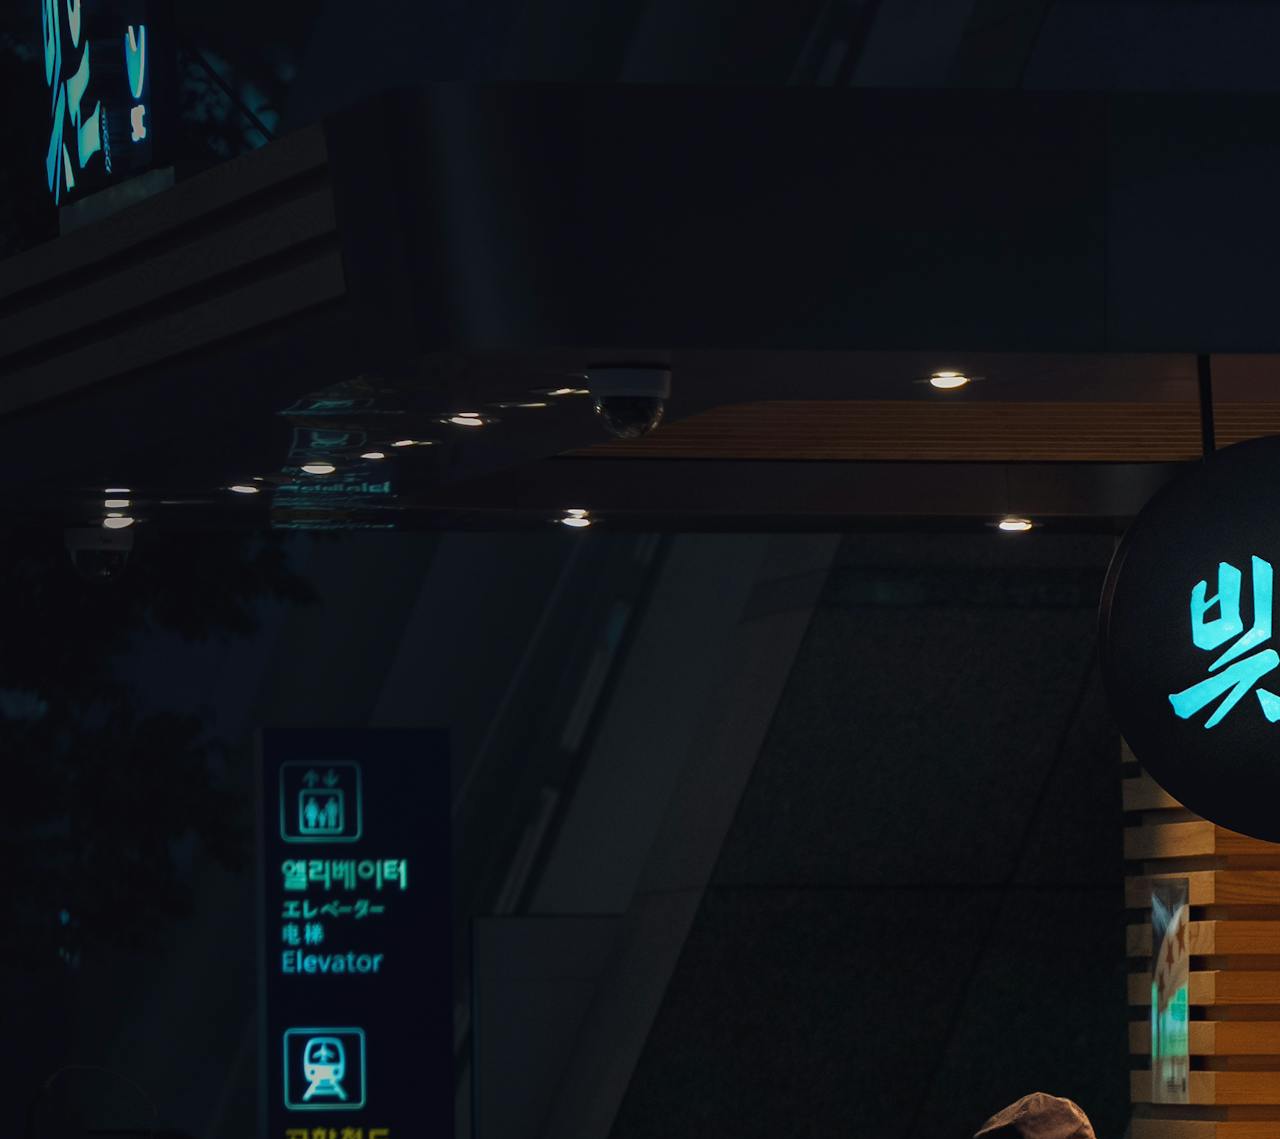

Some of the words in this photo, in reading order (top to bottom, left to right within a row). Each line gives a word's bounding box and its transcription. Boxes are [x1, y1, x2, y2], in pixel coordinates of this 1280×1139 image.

[281, 858, 409, 891] 엘리베이터
[281, 898, 385, 920] エレベーター
[280, 947, 385, 974] Elevator
